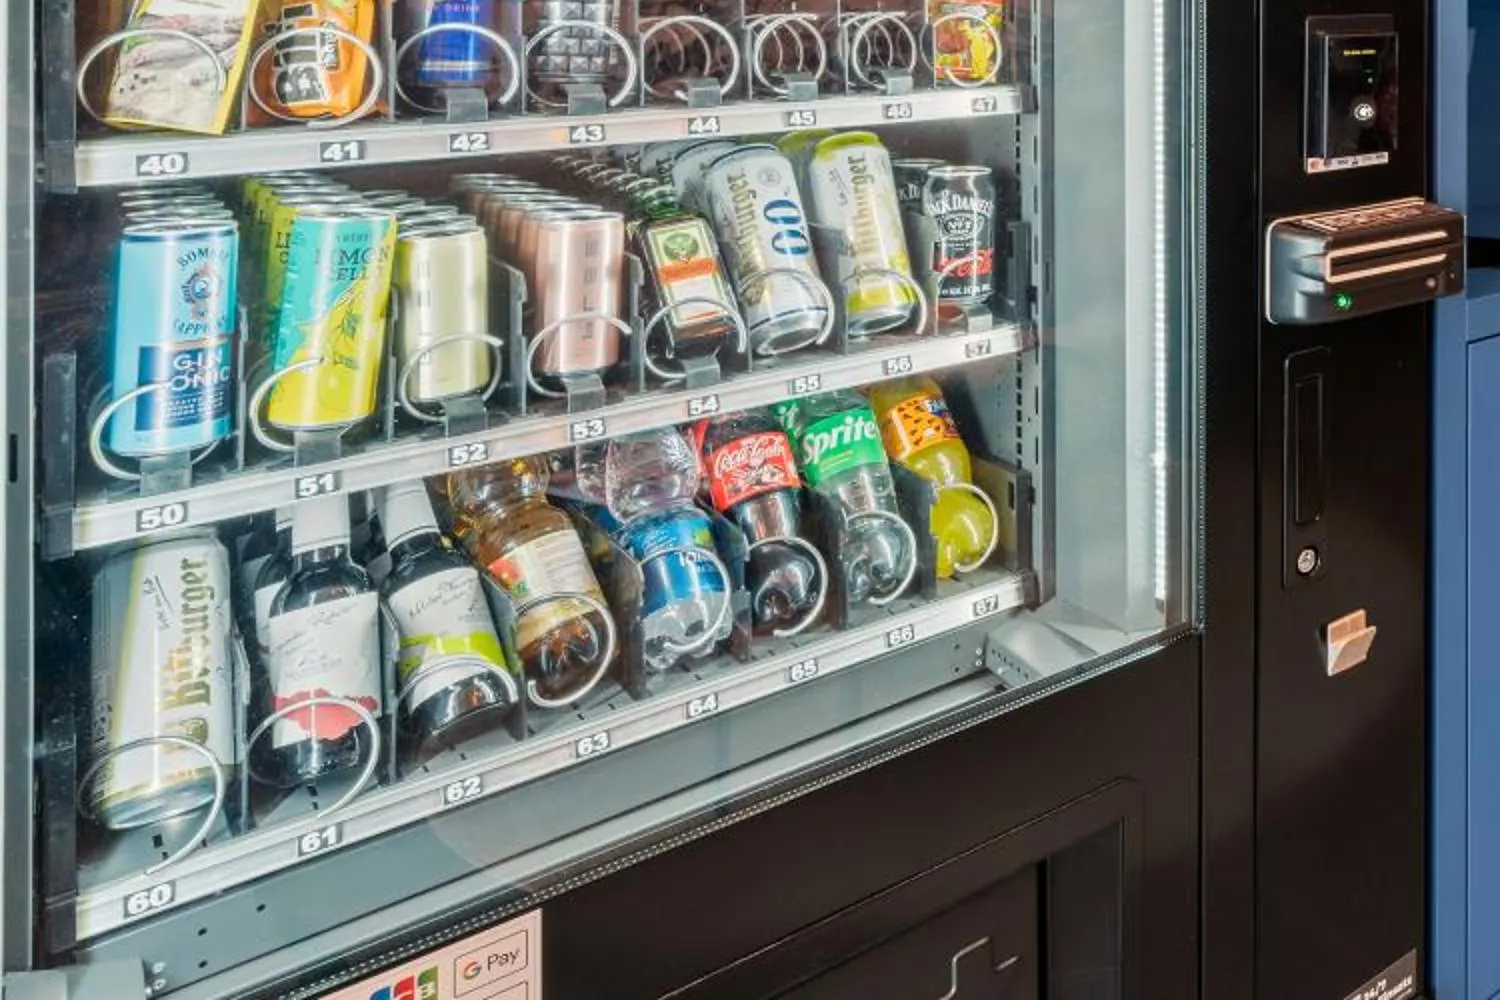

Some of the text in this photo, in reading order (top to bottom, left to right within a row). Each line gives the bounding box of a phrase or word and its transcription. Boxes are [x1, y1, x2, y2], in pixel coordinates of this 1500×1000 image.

[888, 103, 912, 119] 46
[972, 98, 996, 113] 47
[691, 116, 718, 134] 44
[788, 109, 815, 127] 45
[451, 132, 489, 152] 42
[571, 125, 604, 142] 43
[324, 141, 358, 161] 41
[139, 154, 184, 175] 40
[888, 356, 912, 374] 56
[166, 365, 231, 392] ONIC
[794, 373, 821, 392] 55
[690, 395, 718, 415] 54
[573, 421, 606, 439] 53
[802, 415, 877, 465] Sprite
[452, 446, 488, 465] 52
[299, 474, 335, 497] 51
[140, 507, 184, 529] 50
[886, 626, 914, 644] 66
[789, 664, 817, 683] 65
[690, 694, 718, 715] 64
[577, 734, 609, 755] 63
[446, 780, 482, 801] 62
[301, 830, 339, 853] 61
[127, 884, 172, 917] 60
[486, 947, 521, 972] Pay
